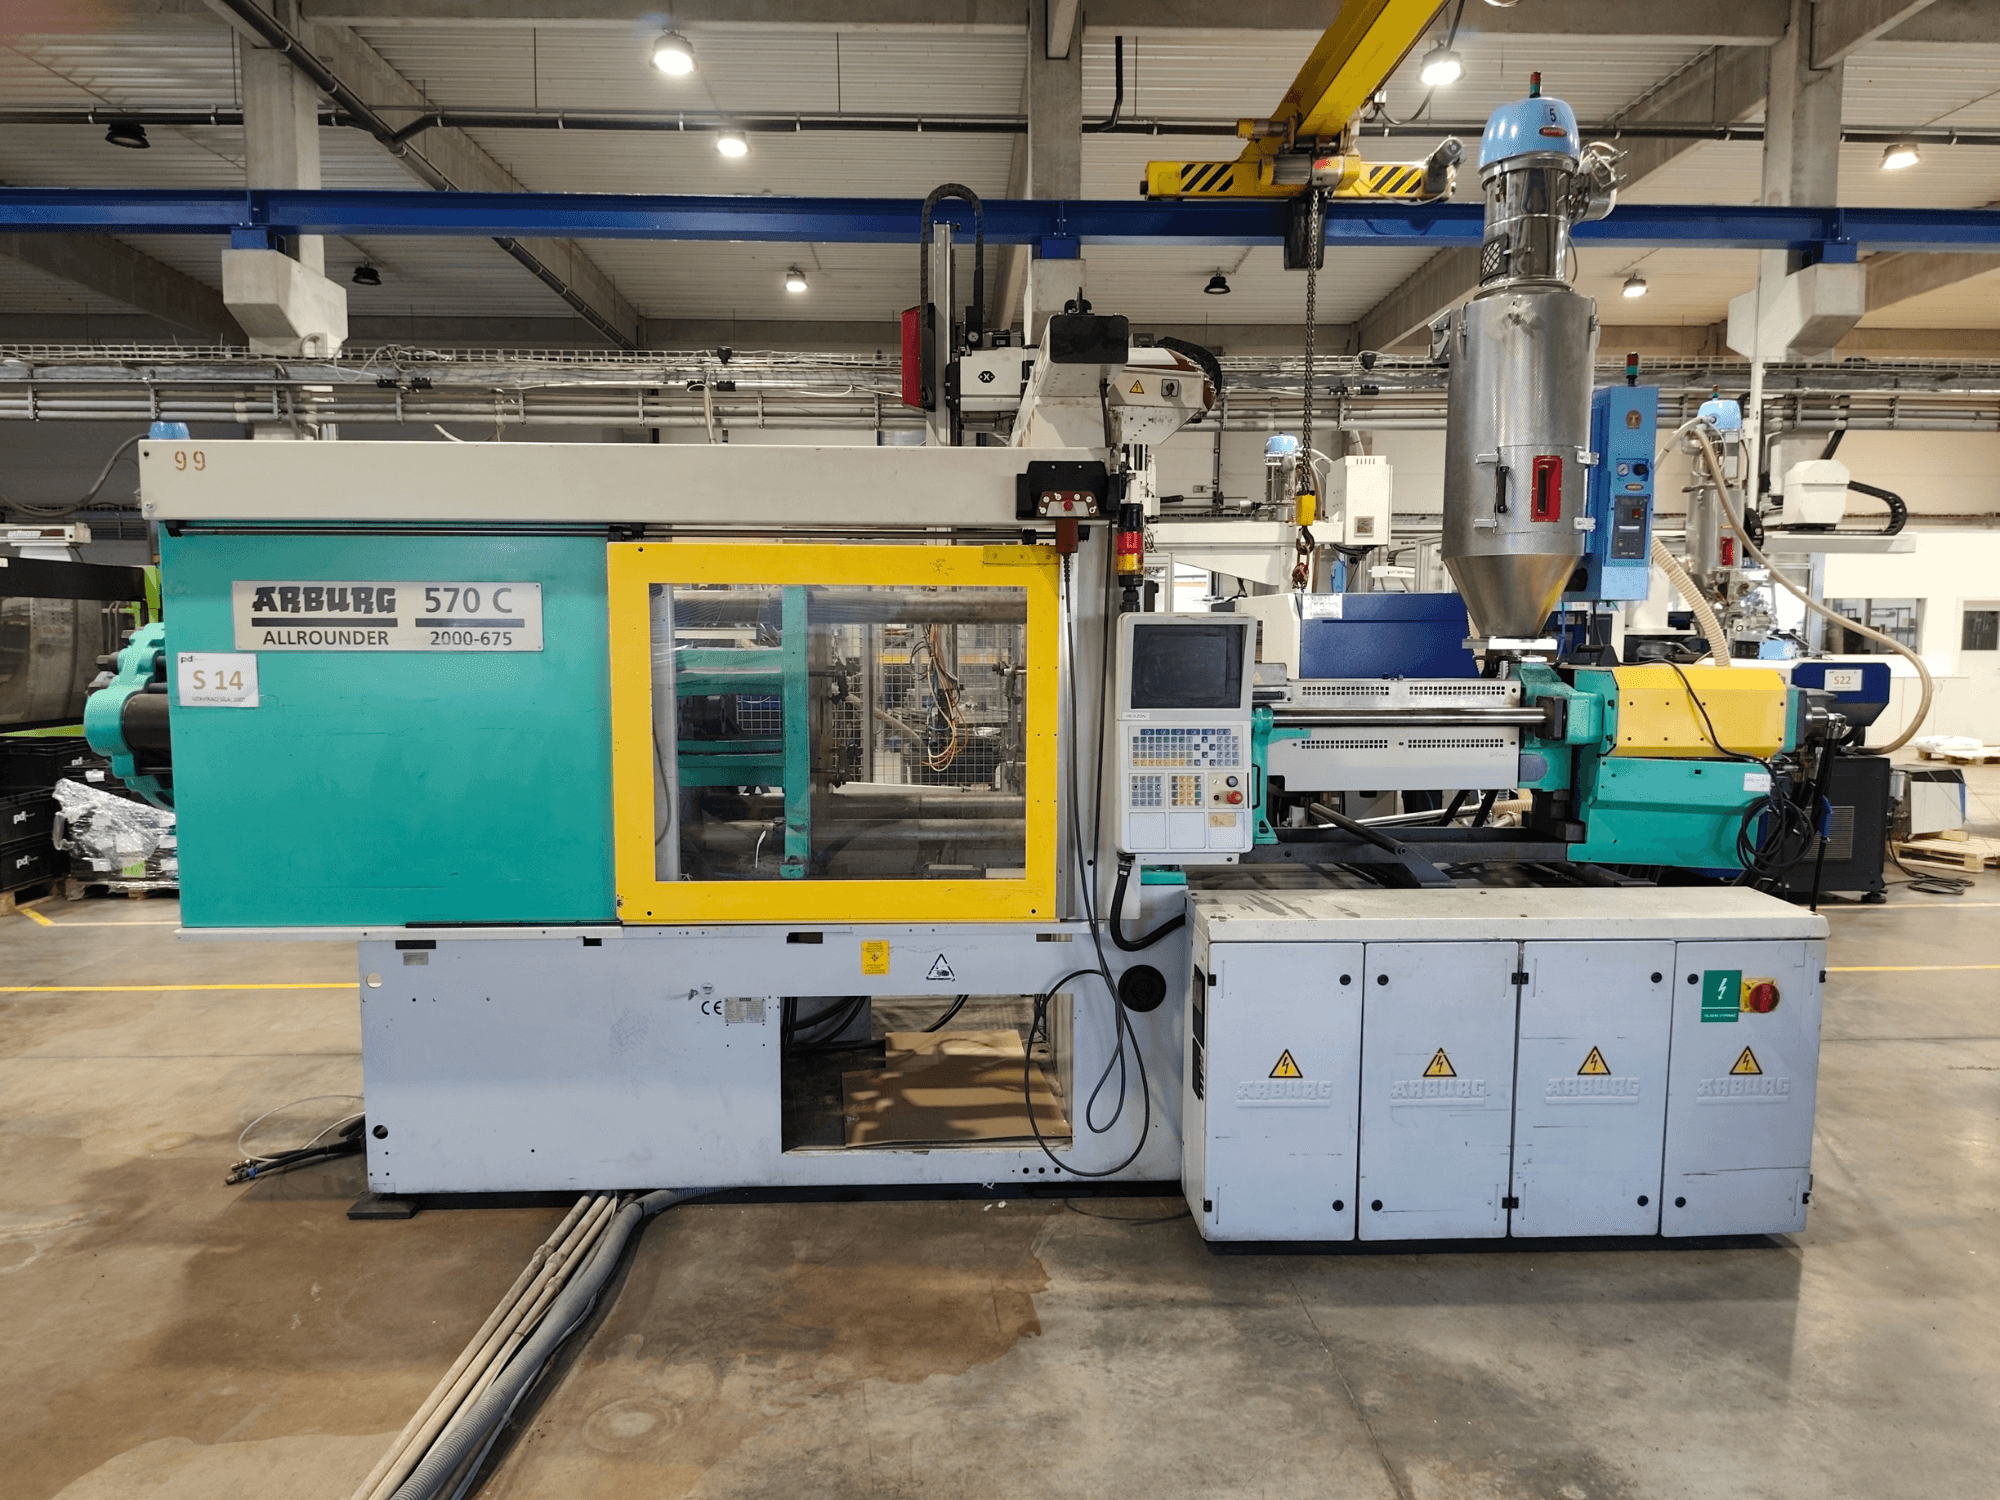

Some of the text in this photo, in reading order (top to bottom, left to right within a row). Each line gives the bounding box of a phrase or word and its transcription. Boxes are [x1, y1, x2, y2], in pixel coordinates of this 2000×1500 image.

[1549, 108, 1557, 122] 5
[174, 450, 206, 472] 99
[251, 586, 513, 615] ARBURG 570 C
[262, 630, 513, 647] ALLROUNDER 2000-675
[193, 669, 243, 690] S 14
[1834, 675, 1851, 685] S22
[1236, 1080, 1331, 1100] ARBURG
[1390, 1079, 1484, 1099] ARBURG
[1545, 1077, 1639, 1097] ARBURG
[1697, 1077, 1789, 1097] ARBURG
